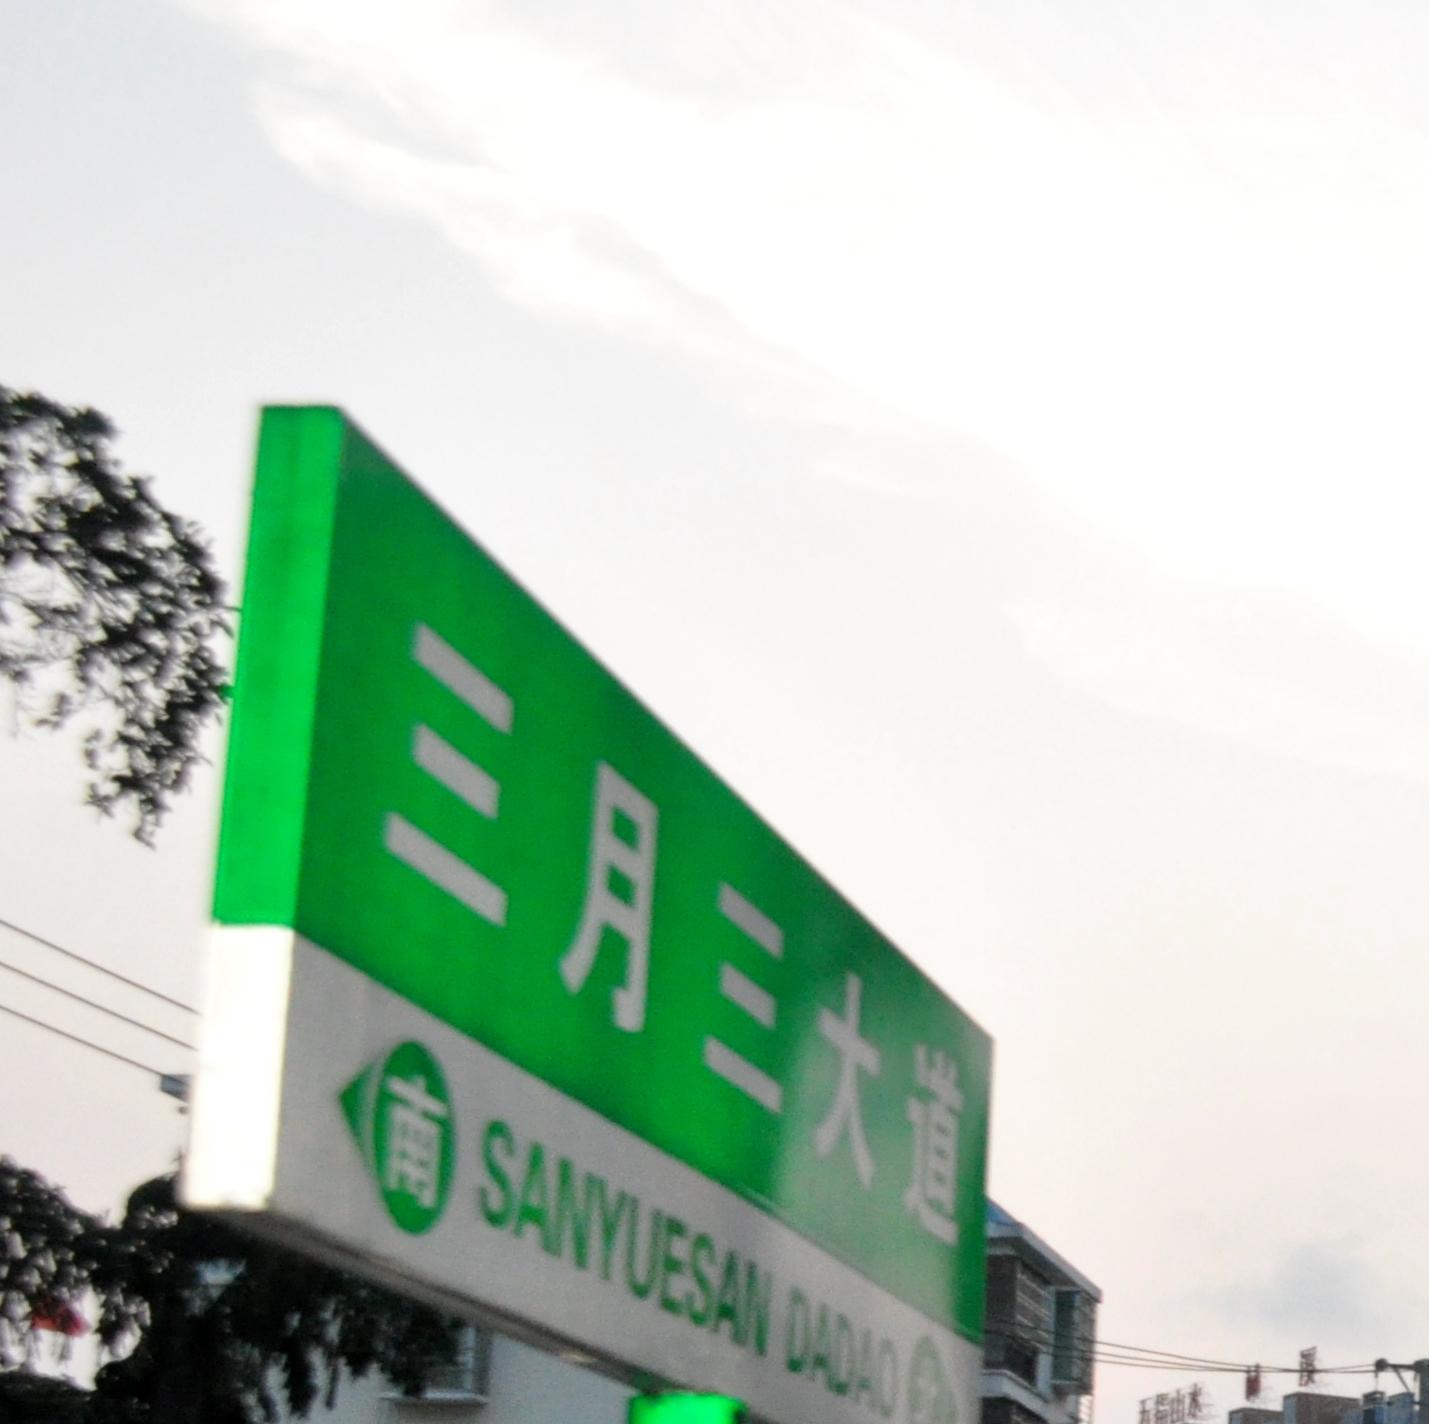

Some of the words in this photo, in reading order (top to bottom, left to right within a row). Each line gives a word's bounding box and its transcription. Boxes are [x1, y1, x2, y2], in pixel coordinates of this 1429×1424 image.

[382, 621, 965, 1248] 三月三大道
[387, 1075, 448, 1208] 南
[479, 1120, 773, 1356] SANYUESAN
[785, 1290, 898, 1420] DADAO
